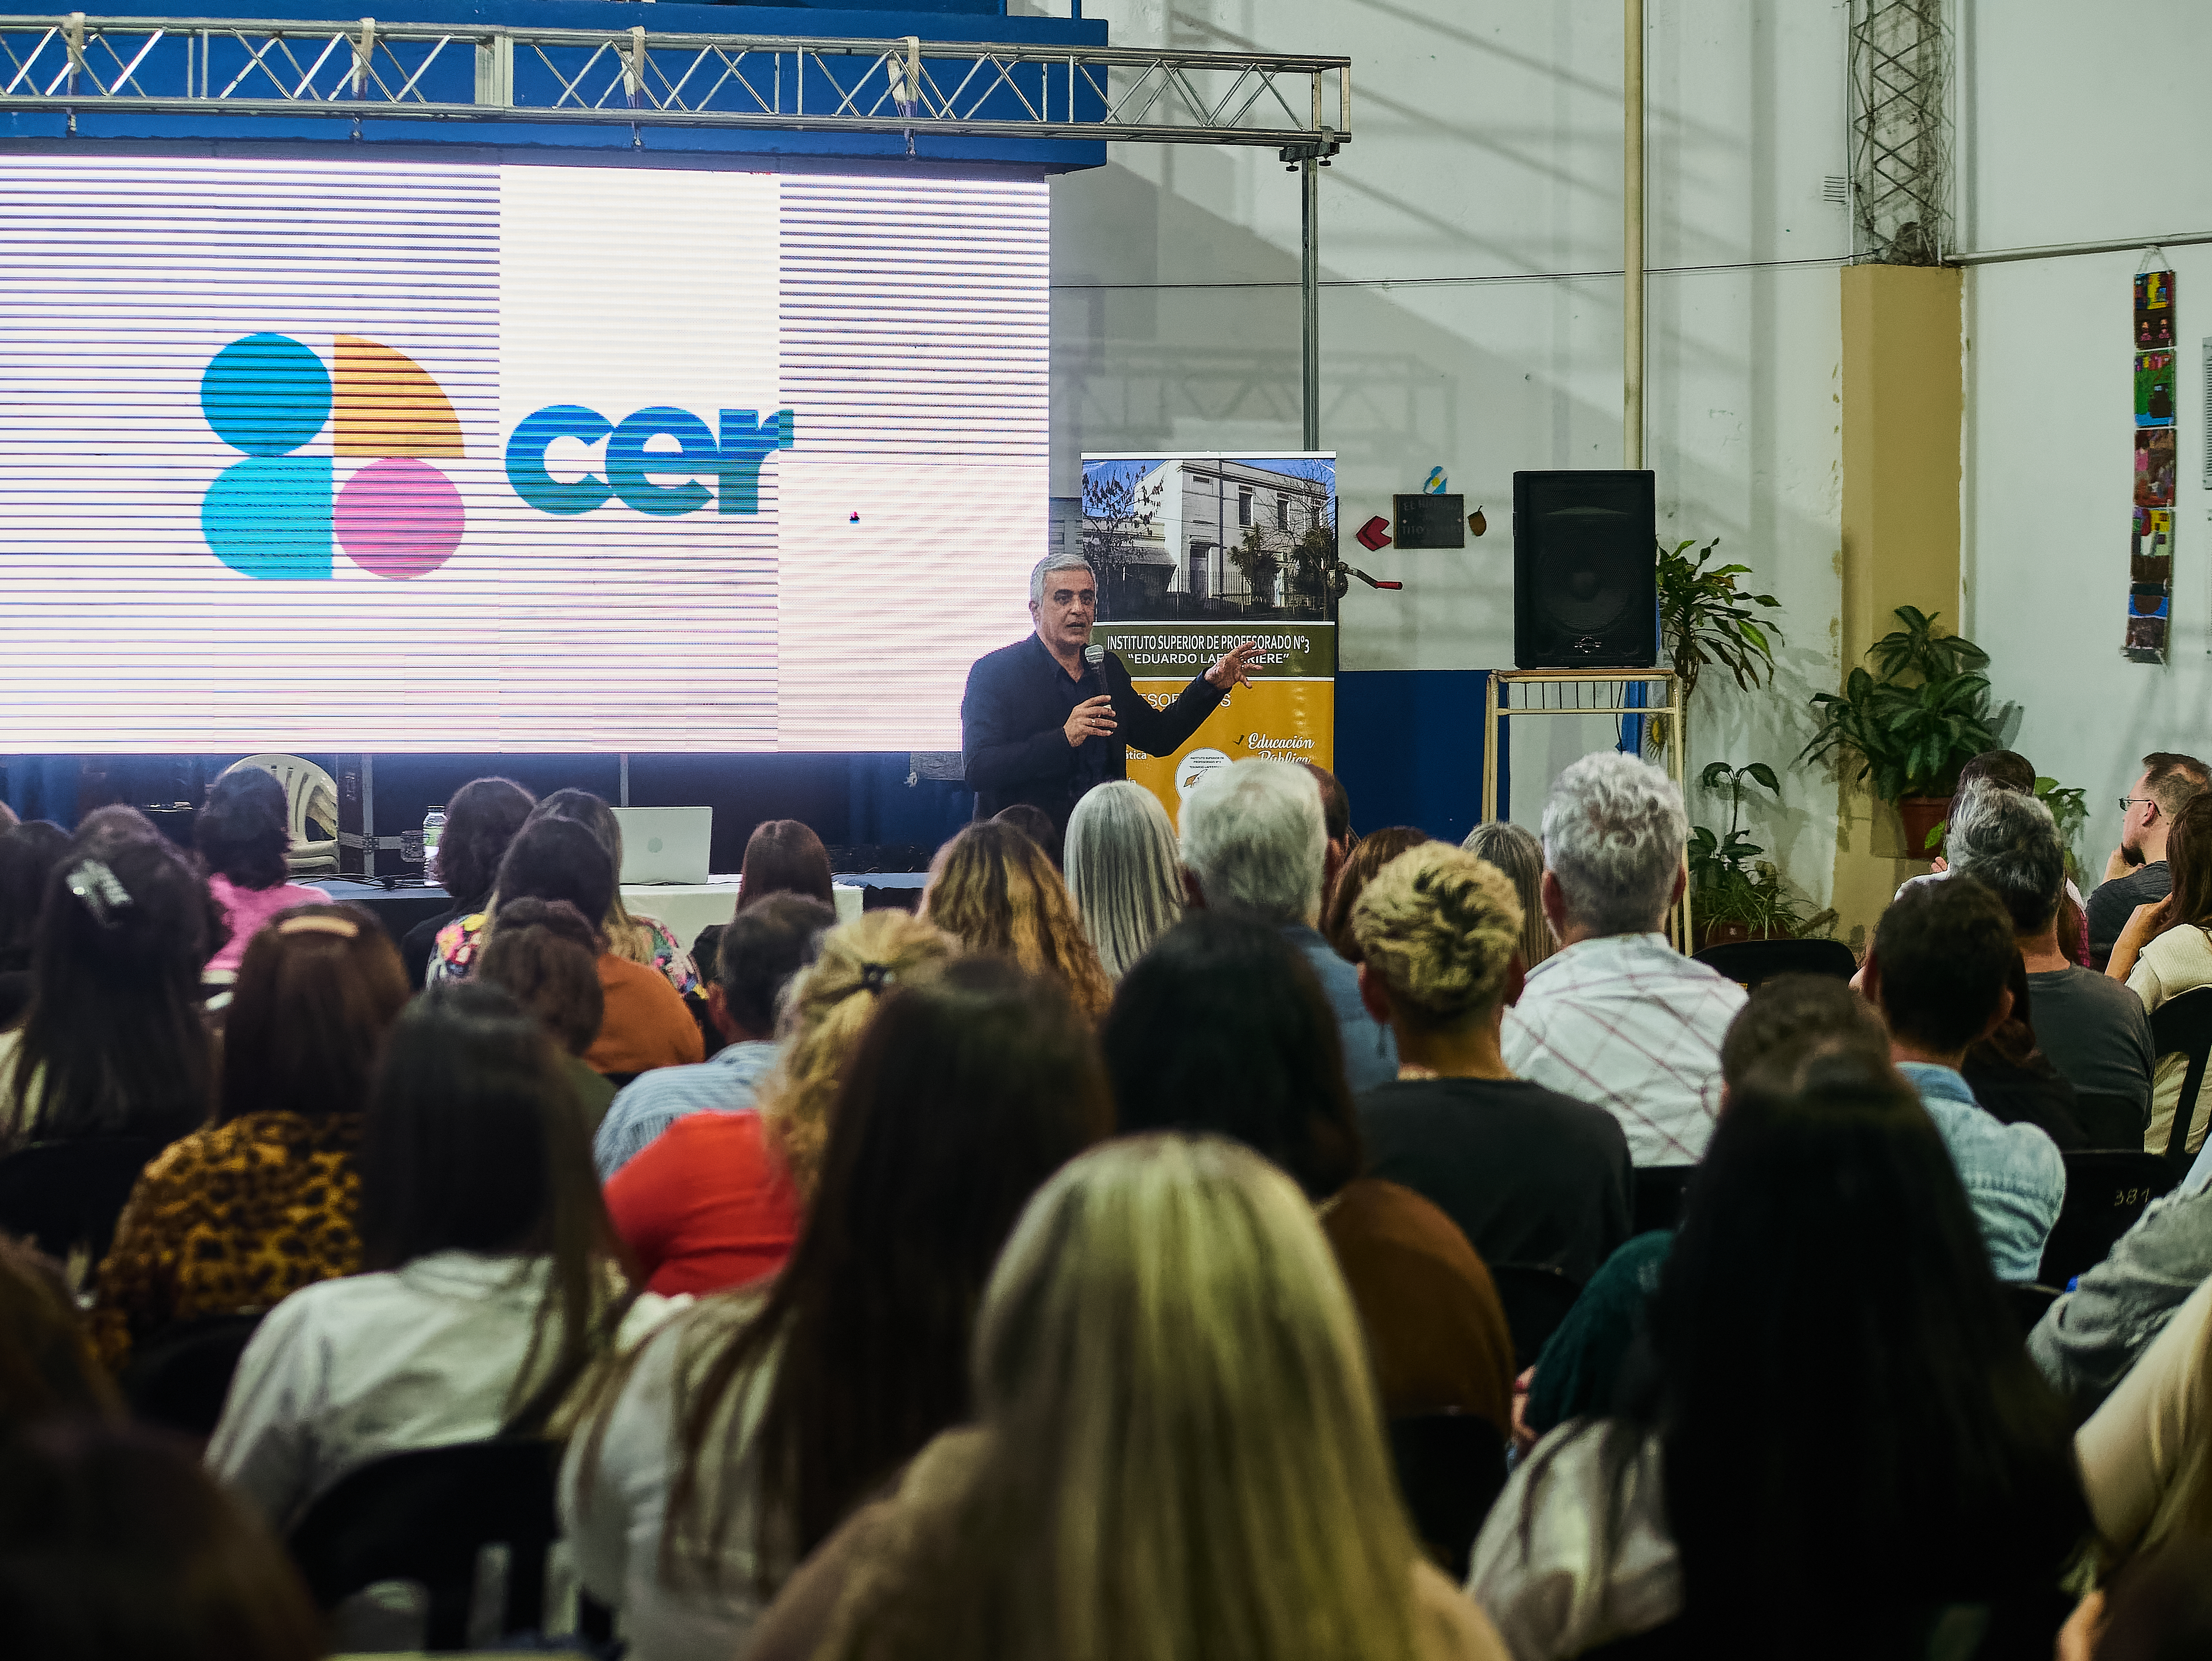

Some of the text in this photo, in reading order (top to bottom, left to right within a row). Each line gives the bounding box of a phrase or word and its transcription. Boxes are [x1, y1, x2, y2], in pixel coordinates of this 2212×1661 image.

[505, 404, 793, 515] cer
[1107, 635, 1156, 650] INSTITUTO
[1158, 635, 1205, 650] SUPERIOR
[1207, 635, 1219, 649] DE
[1128, 653, 1197, 664] “EDUARDO
[1248, 732, 1315, 749] Educación
